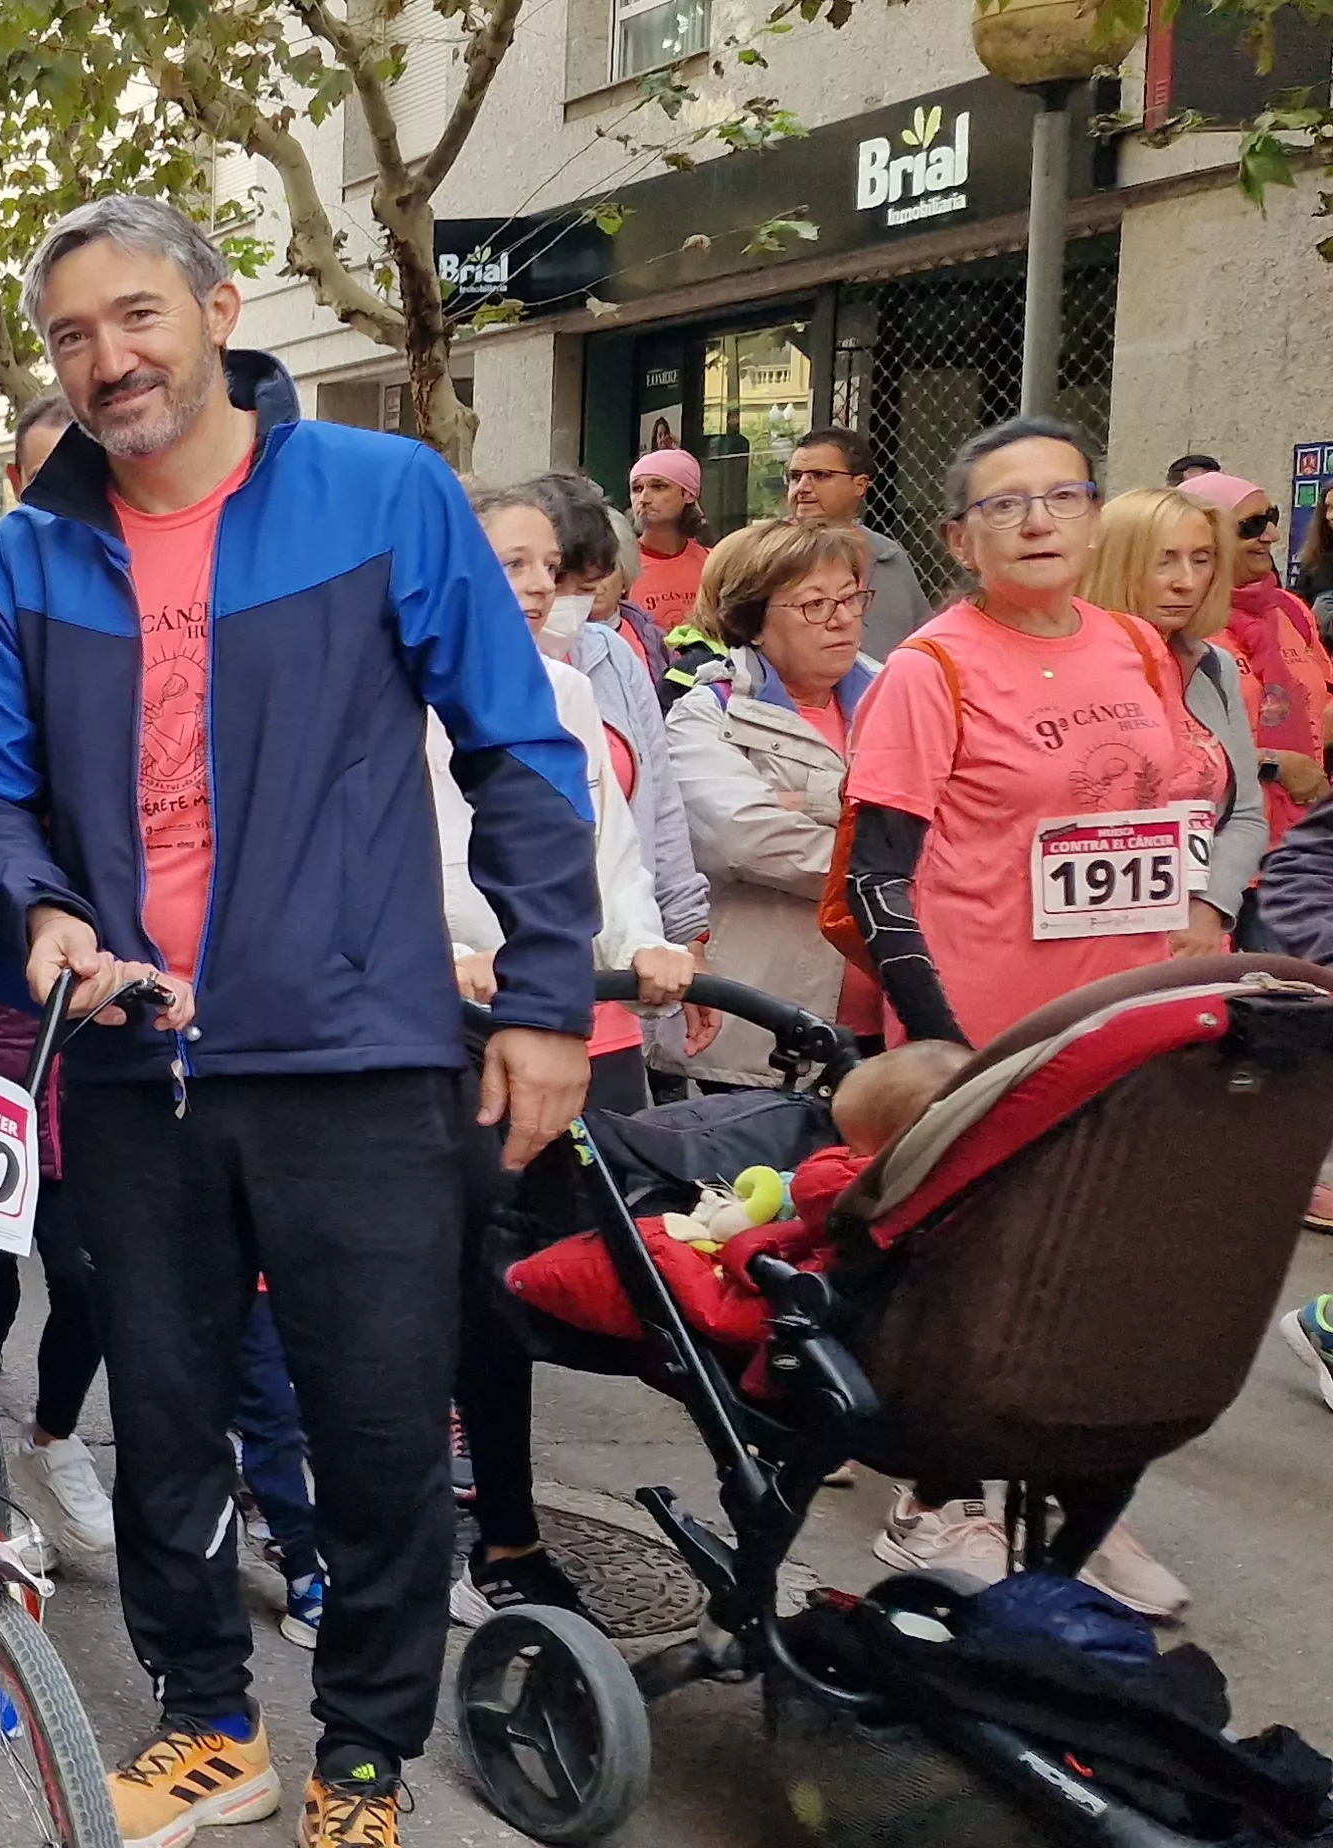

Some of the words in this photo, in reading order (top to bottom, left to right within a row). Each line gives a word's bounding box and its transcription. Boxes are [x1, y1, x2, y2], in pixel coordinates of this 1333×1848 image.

[856, 111, 970, 211] Brial
[886, 192, 967, 226] Inmobiliaria
[438, 252, 509, 284] Brial
[141, 602, 207, 634] CÁNC
[1035, 716, 1070, 750] 9ª
[1072, 702, 1146, 727] CÁNCER
[1050, 840, 1110, 853] CONTRA
[1111, 838, 1126, 850] EL
[1127, 833, 1175, 849] CÁNCER
[1049, 855, 1175, 907] 1915
